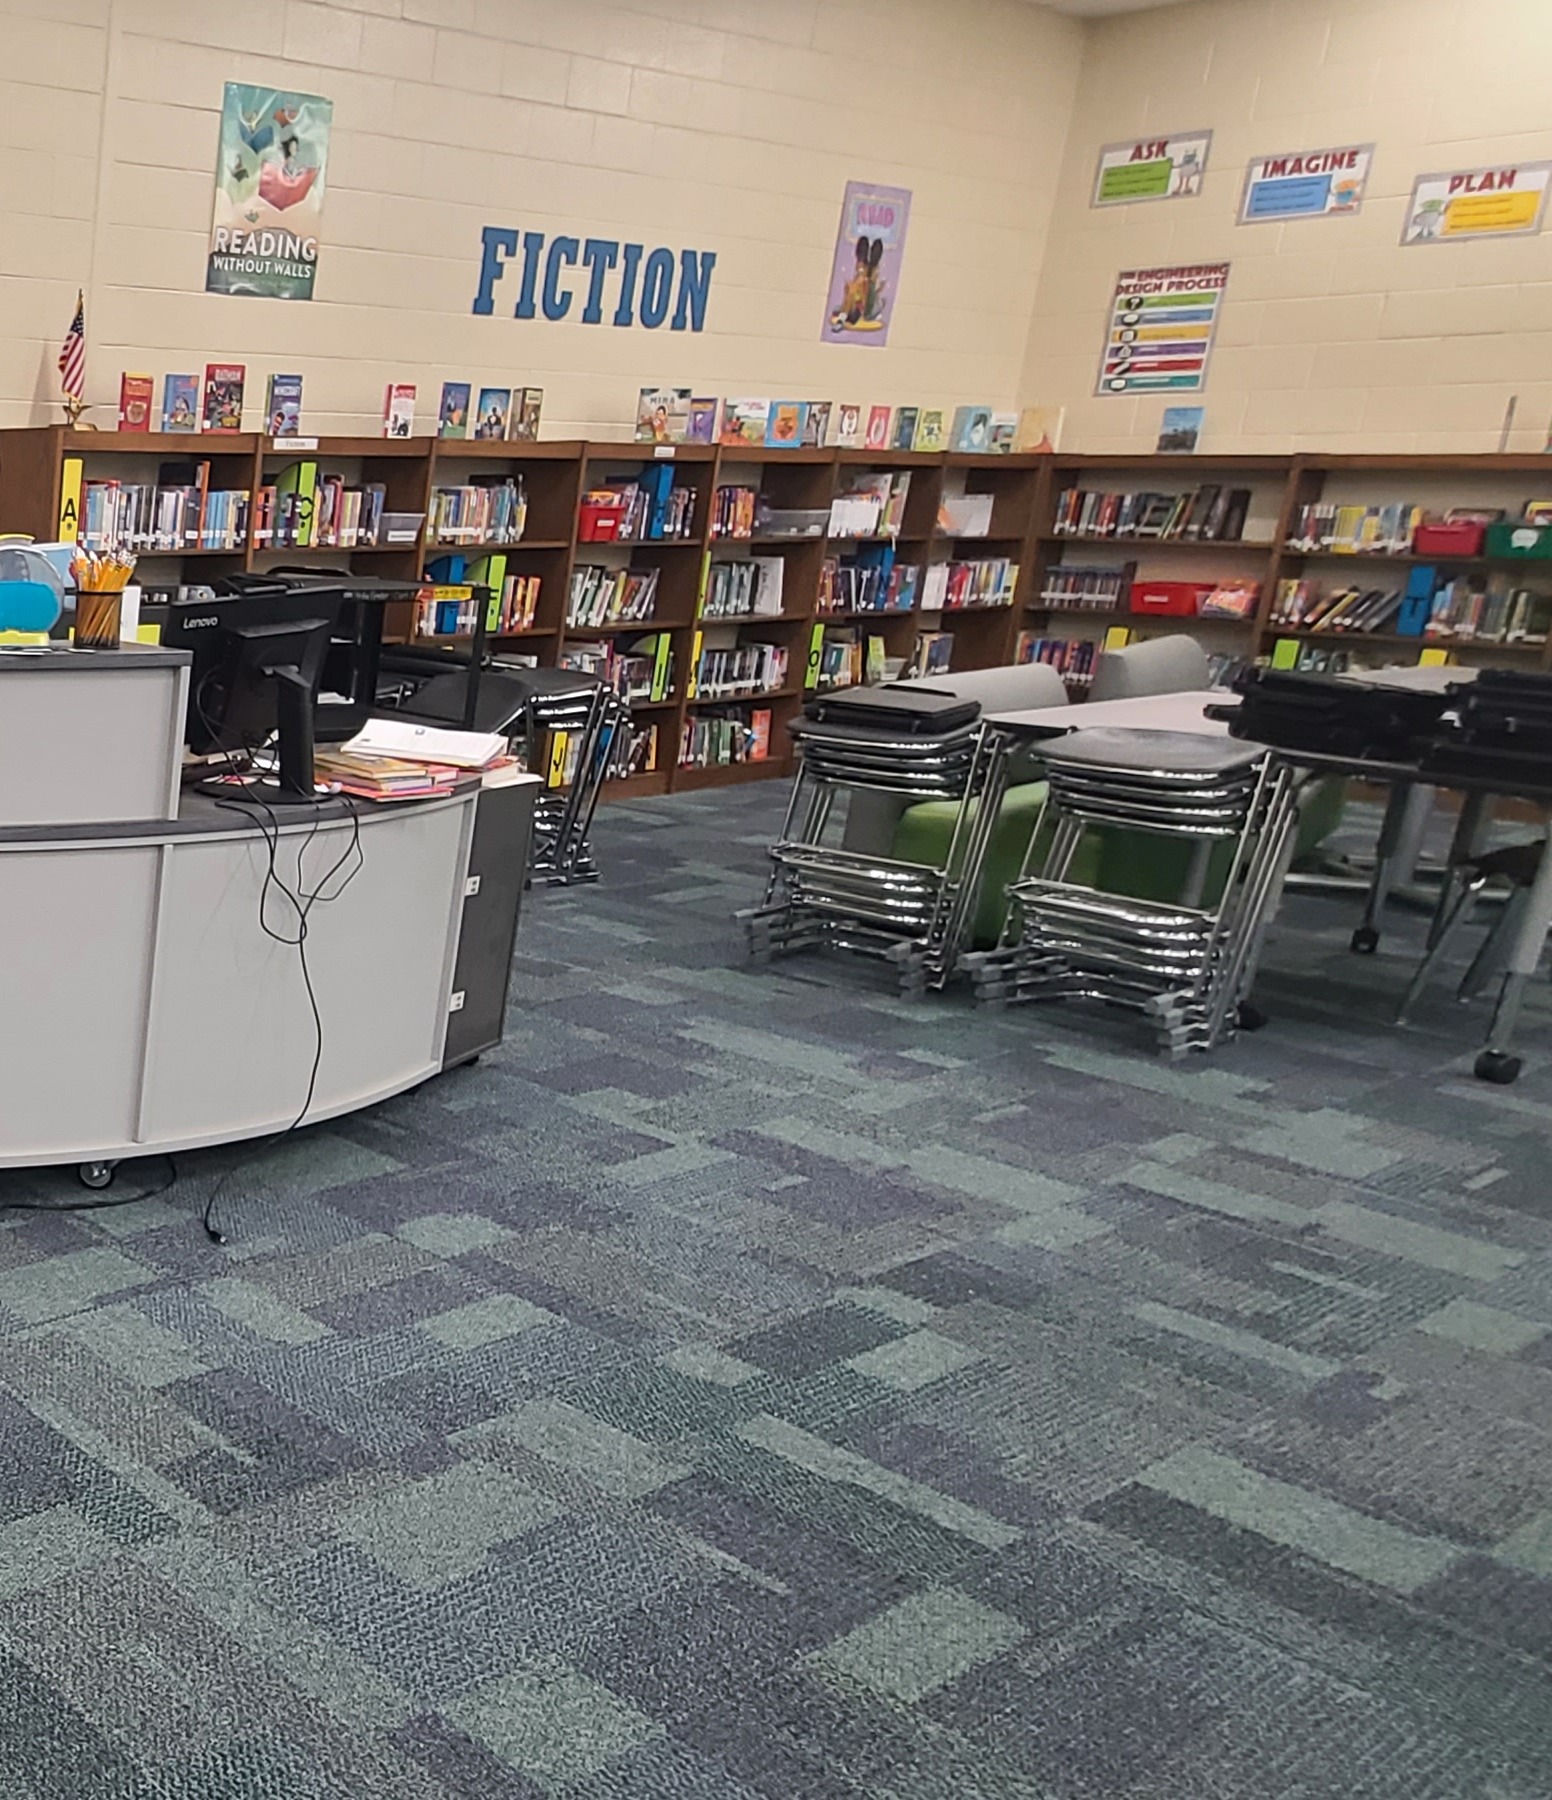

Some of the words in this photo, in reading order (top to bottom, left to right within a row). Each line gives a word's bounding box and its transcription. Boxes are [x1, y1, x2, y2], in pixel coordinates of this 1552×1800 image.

[1129, 140, 1169, 162] ASK
[1261, 150, 1360, 180] IMAGINE
[1448, 169, 1518, 194] PLAN
[214, 226, 318, 262] READING
[212, 254, 271, 275] WITHOUT
[273, 262, 312, 279] WALLS
[1137, 262, 1230, 281] ENGINEERING
[472, 226, 717, 332] FICTION
[1115, 281, 1163, 297] DESIGN
[1166, 277, 1228, 292] PROCESS
[61, 498, 78, 522] A
[183, 615, 219, 630] Lenovo
